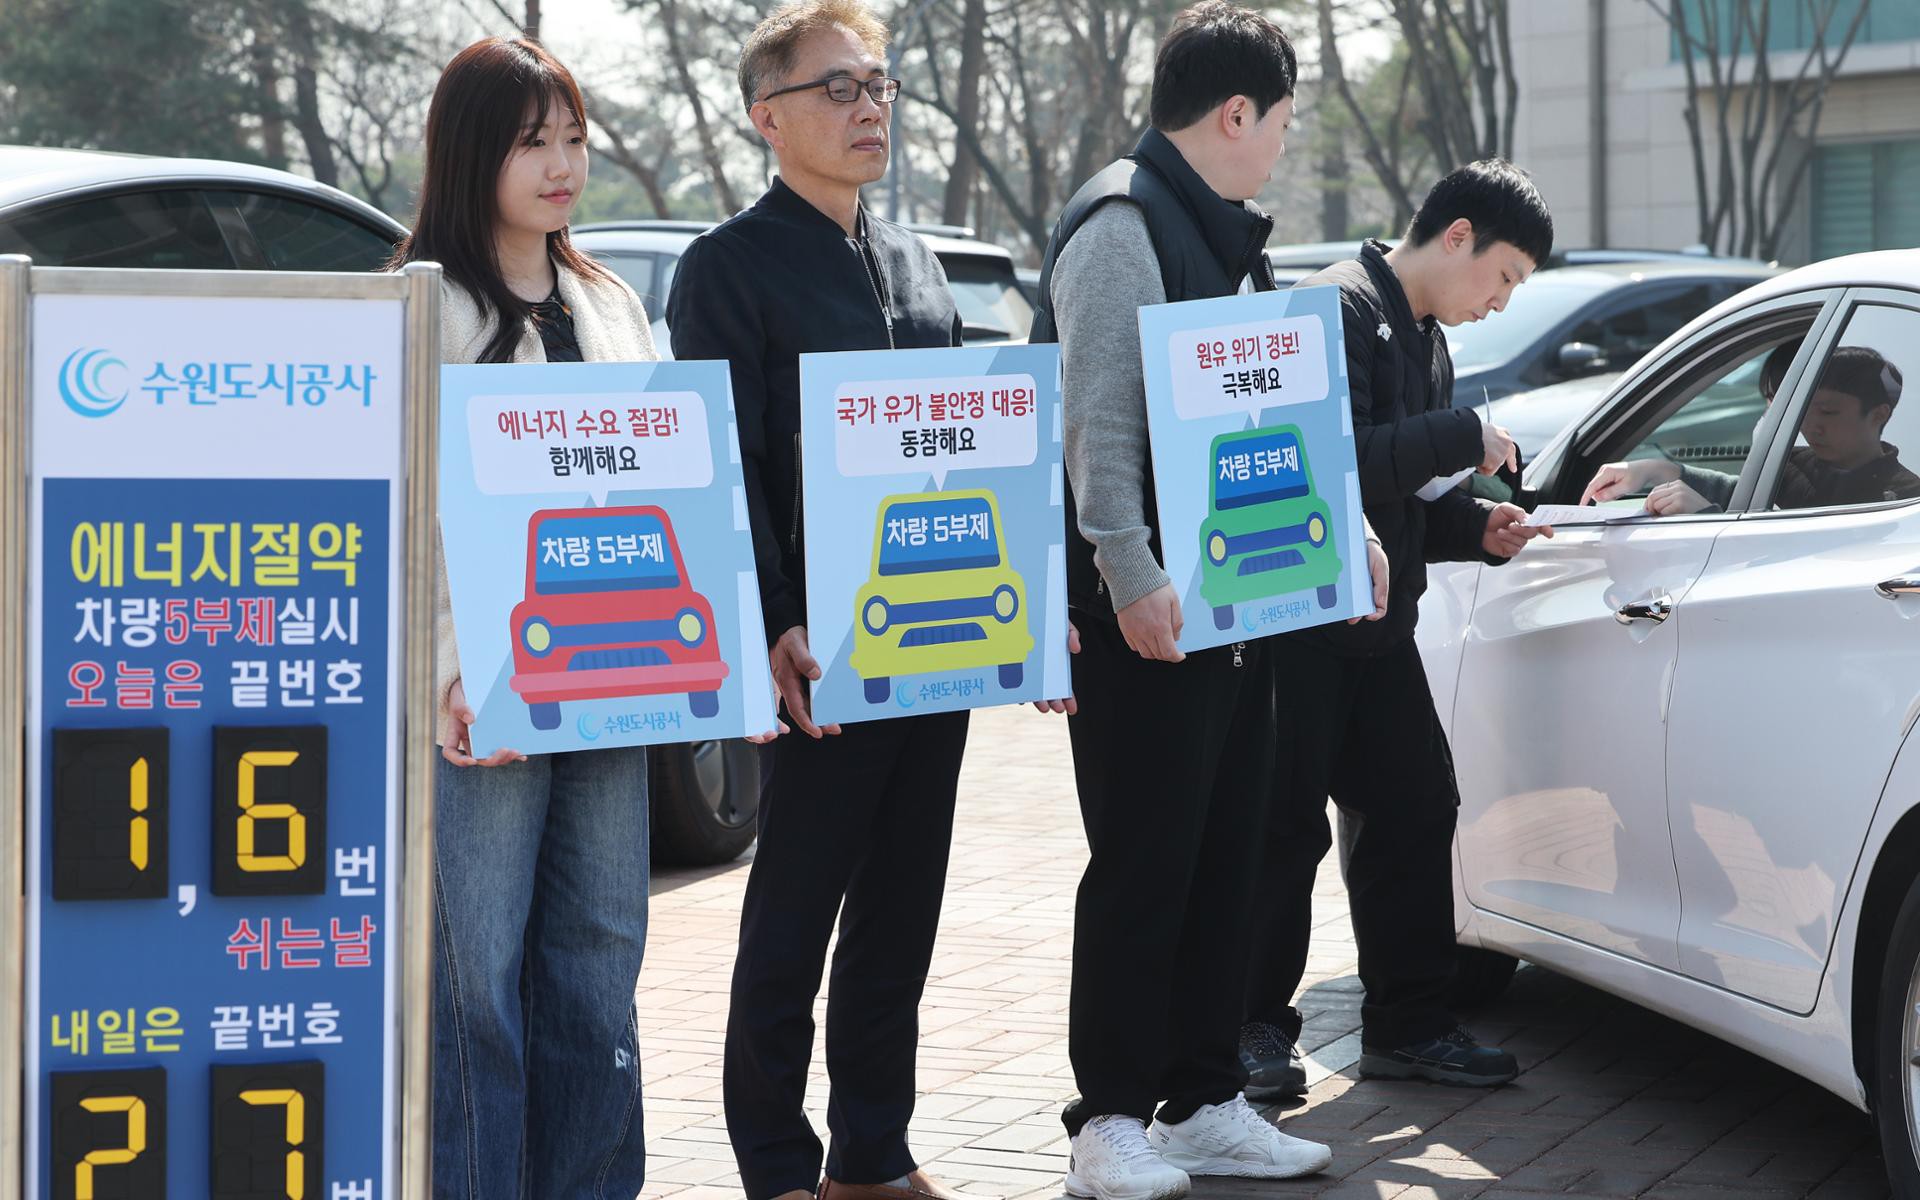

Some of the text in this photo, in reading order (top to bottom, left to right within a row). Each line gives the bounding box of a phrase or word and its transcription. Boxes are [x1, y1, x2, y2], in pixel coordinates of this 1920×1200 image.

[1196, 332, 1300, 369] 원유 위기 경보!
[141, 362, 376, 407] 수원도시공사
[1222, 367, 1282, 399] 극복해요
[498, 407, 679, 440] 에너지 수요 절감!
[837, 388, 1035, 425] 국가 유가 불안정 대응!
[900, 427, 976, 458] 동참해요
[548, 446, 640, 477] 함께해요
[1218, 445, 1300, 482] 차량 5부제
[887, 512, 989, 547] 차량 5부제
[70, 521, 363, 587] 에너지절약
[542, 532, 664, 567] 차량 5부제
[73, 597, 359, 647] 차량5부제실시
[1259, 598, 1310, 624] 수원도시공사
[66, 659, 364, 709] 오늘은 끝번호
[919, 678, 984, 700] 수원도시공사
[604, 711, 682, 735] 수원도시공사
[226, 915, 376, 970] 쉬는날
[51, 1002, 343, 1056] 내일은 끝번호
[75, 1089, 304, 1200] 2 7
